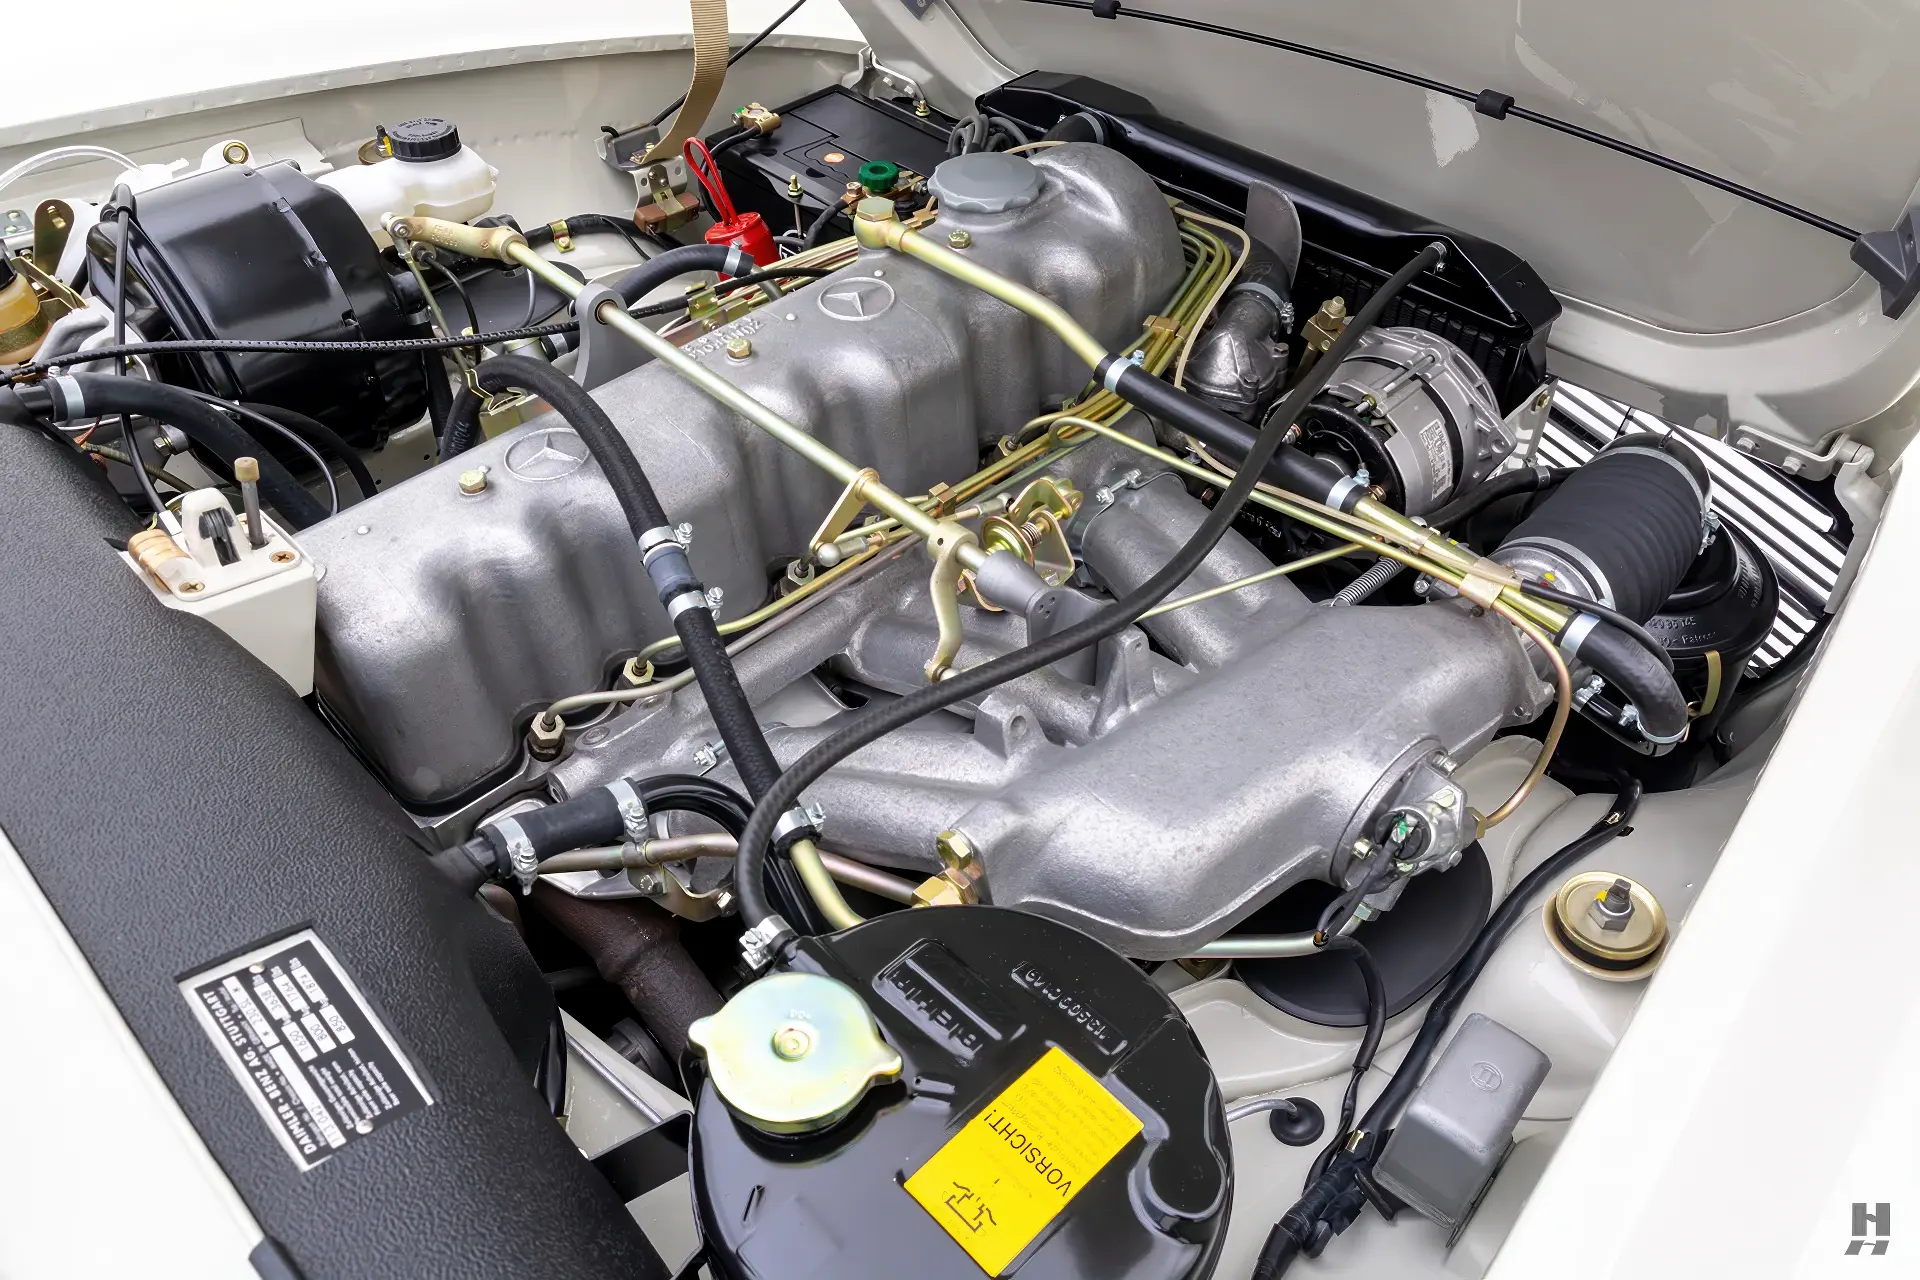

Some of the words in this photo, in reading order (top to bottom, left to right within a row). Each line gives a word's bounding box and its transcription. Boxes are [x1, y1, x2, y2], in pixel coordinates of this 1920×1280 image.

[299, 973, 318, 994] 1874
[202, 990, 247, 1047] STUTTGART
[328, 1014, 347, 1033] 850
[288, 1029, 310, 1052] 1650
[310, 1023, 328, 1041] 800
[241, 1046, 261, 1066] AG.
[253, 1067, 318, 1155] DAIMLER-BENZ
[982, 1106, 1073, 1196] VORSICHT!
